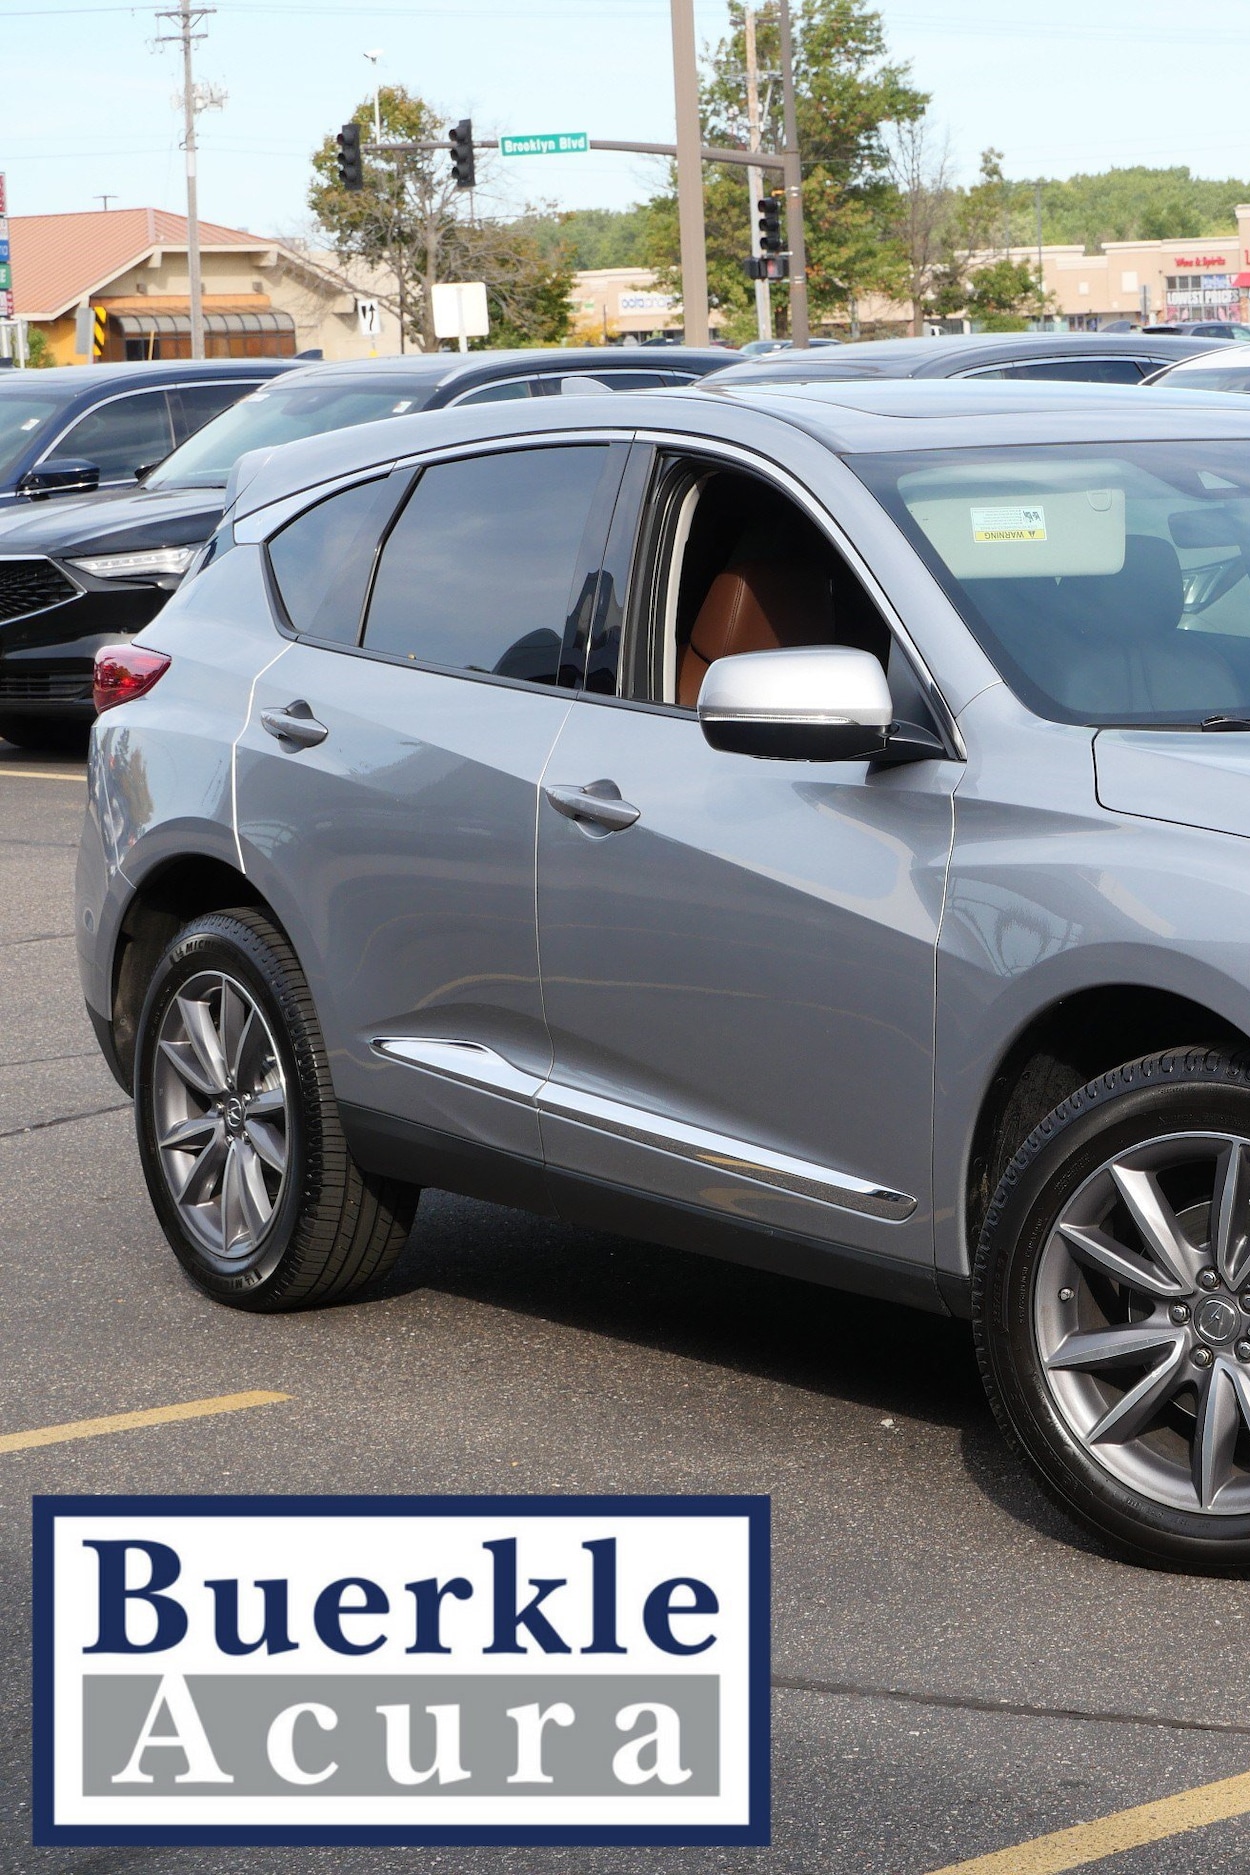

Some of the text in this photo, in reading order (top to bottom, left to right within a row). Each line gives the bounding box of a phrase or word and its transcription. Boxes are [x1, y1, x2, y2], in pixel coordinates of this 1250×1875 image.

[504, 136, 585, 153] Brooklyn Blvd
[1205, 290, 1240, 304] PRICES
[984, 531, 1025, 540] WARNING
